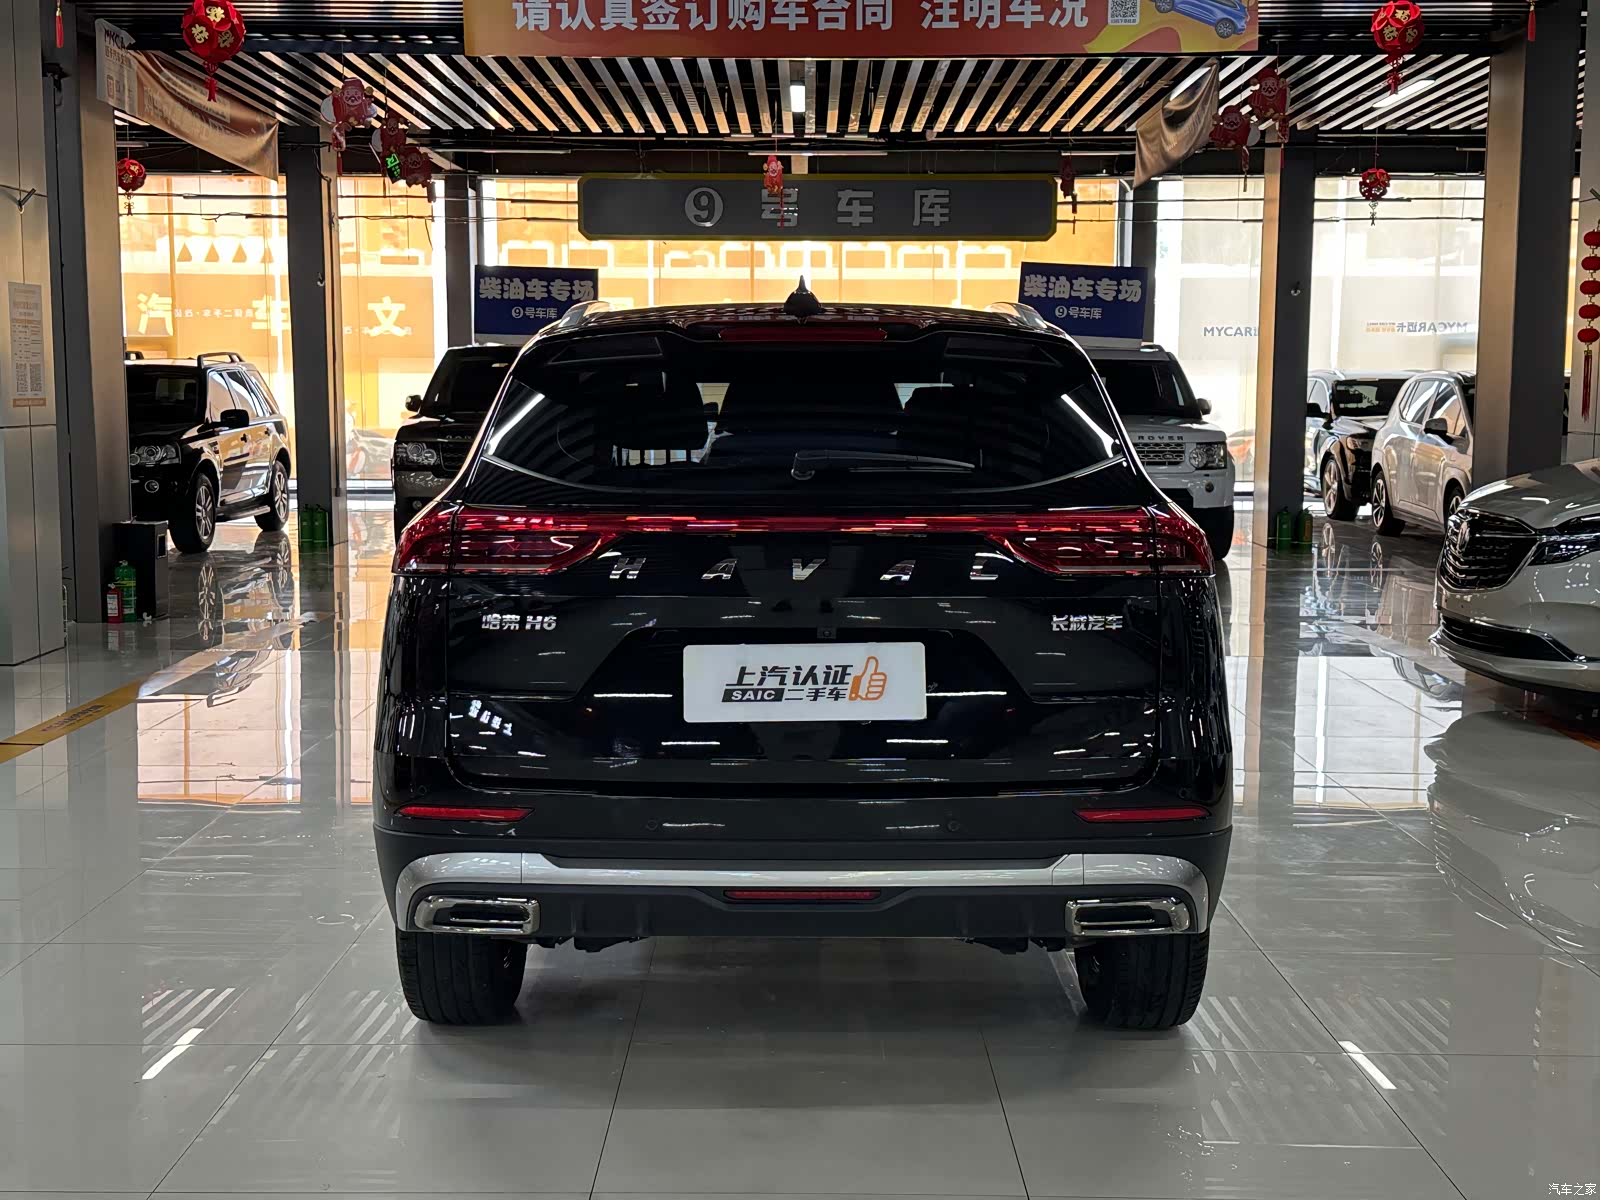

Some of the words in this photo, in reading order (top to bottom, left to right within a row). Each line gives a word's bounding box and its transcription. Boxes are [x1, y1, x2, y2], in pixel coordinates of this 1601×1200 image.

[512, 0, 893, 32] 请认真签订购车合同
[479, 276, 595, 302] 柴油车专场
[1023, 274, 1142, 303] 柴油车专场
[609, 557, 1000, 582] HAVAL
[481, 613, 521, 630] 哈弗
[525, 615, 557, 630] H6
[1051, 614, 1123, 631] 长城汽车
[725, 664, 854, 687] 上汽认证
[731, 689, 777, 701] SAIC
[784, 687, 849, 702] 二手车
